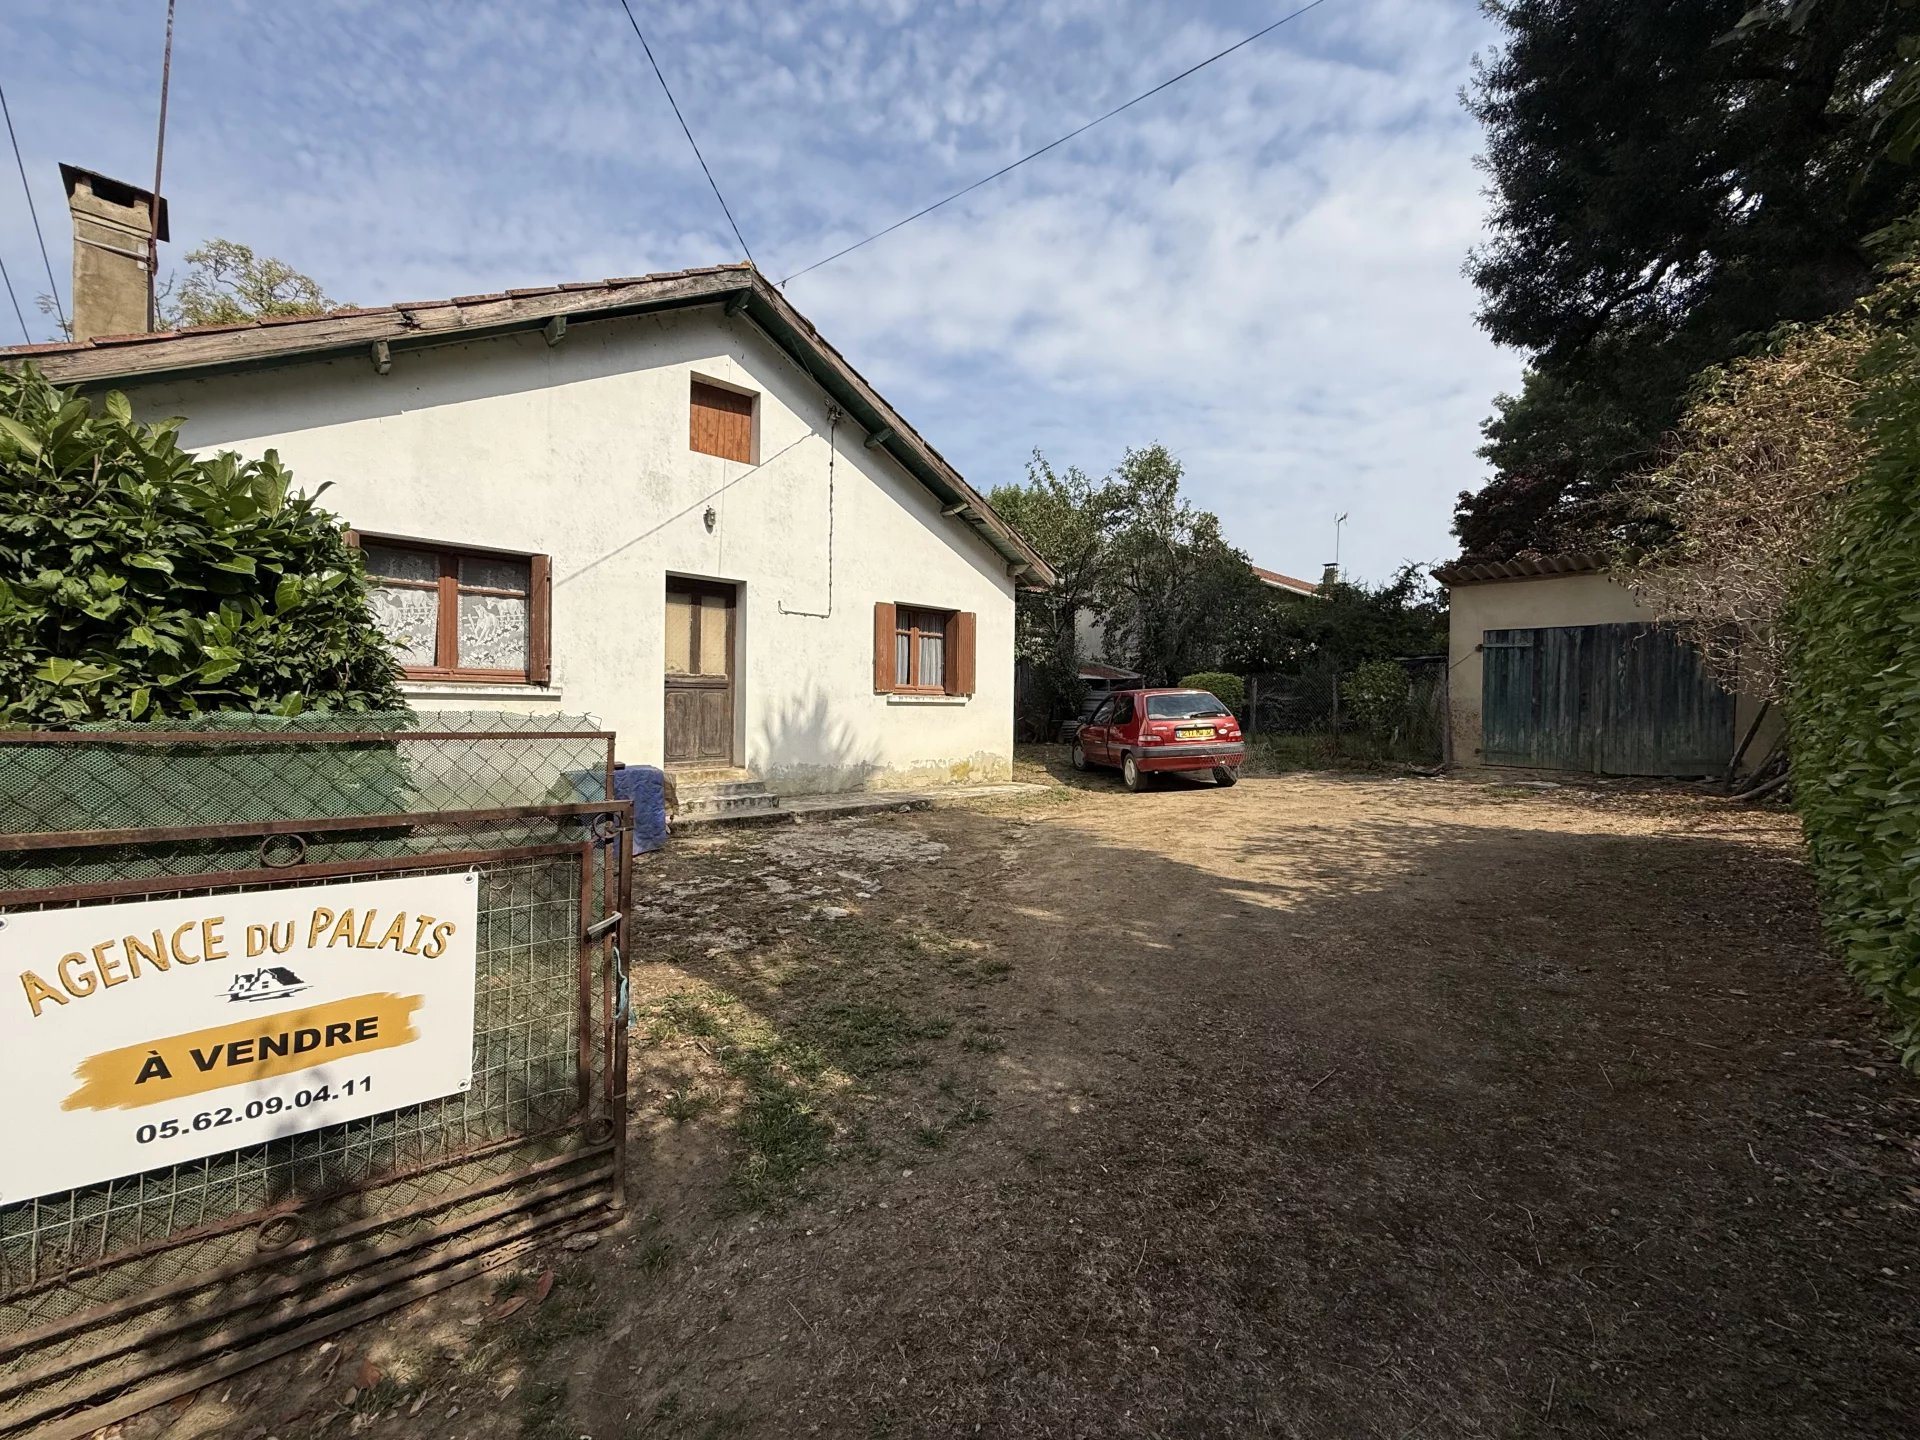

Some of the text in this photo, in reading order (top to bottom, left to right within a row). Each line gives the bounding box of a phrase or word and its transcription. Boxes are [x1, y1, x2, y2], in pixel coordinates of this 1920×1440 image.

[19, 907, 456, 1017] AGENCE DU PALAIS
[134, 1016, 380, 1085] À VENDRE
[136, 1076, 372, 1144] 05.62.09.04.11
